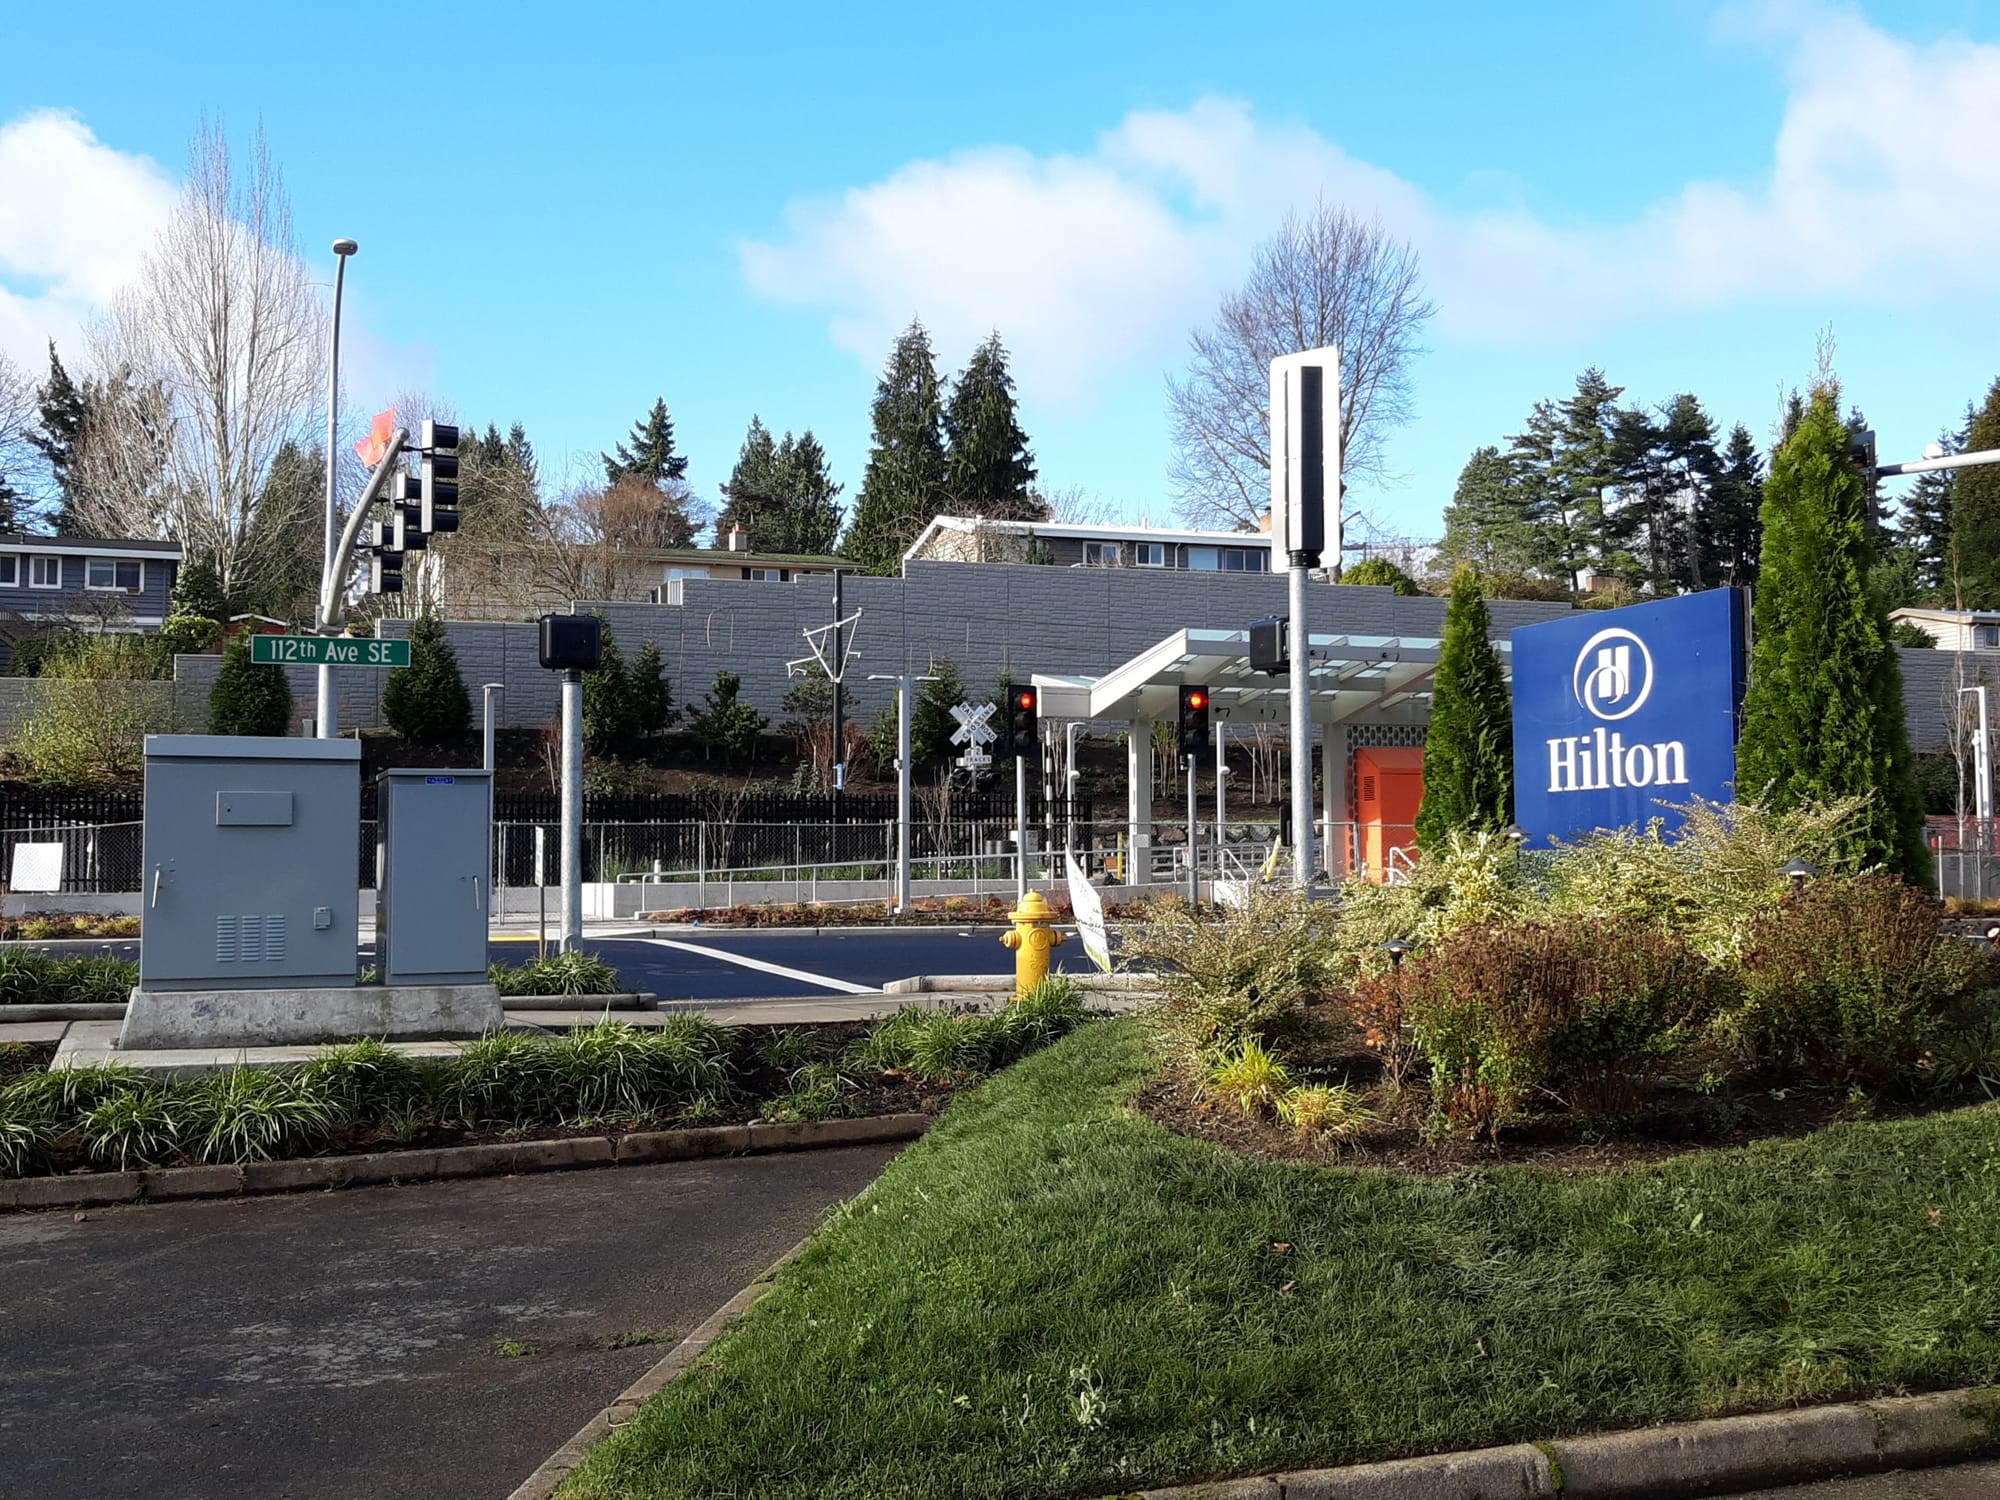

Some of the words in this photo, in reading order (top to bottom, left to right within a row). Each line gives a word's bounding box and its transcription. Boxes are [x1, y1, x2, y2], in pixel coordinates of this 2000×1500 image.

[271, 640, 316, 660] 112th
[325, 641, 358, 662] Ave
[368, 643, 392, 663] SE
[961, 704, 974, 719] RAIL
[980, 724, 996, 741] ROAD
[963, 705, 995, 739] CROSSING
[1546, 727, 1689, 793] Hilton
